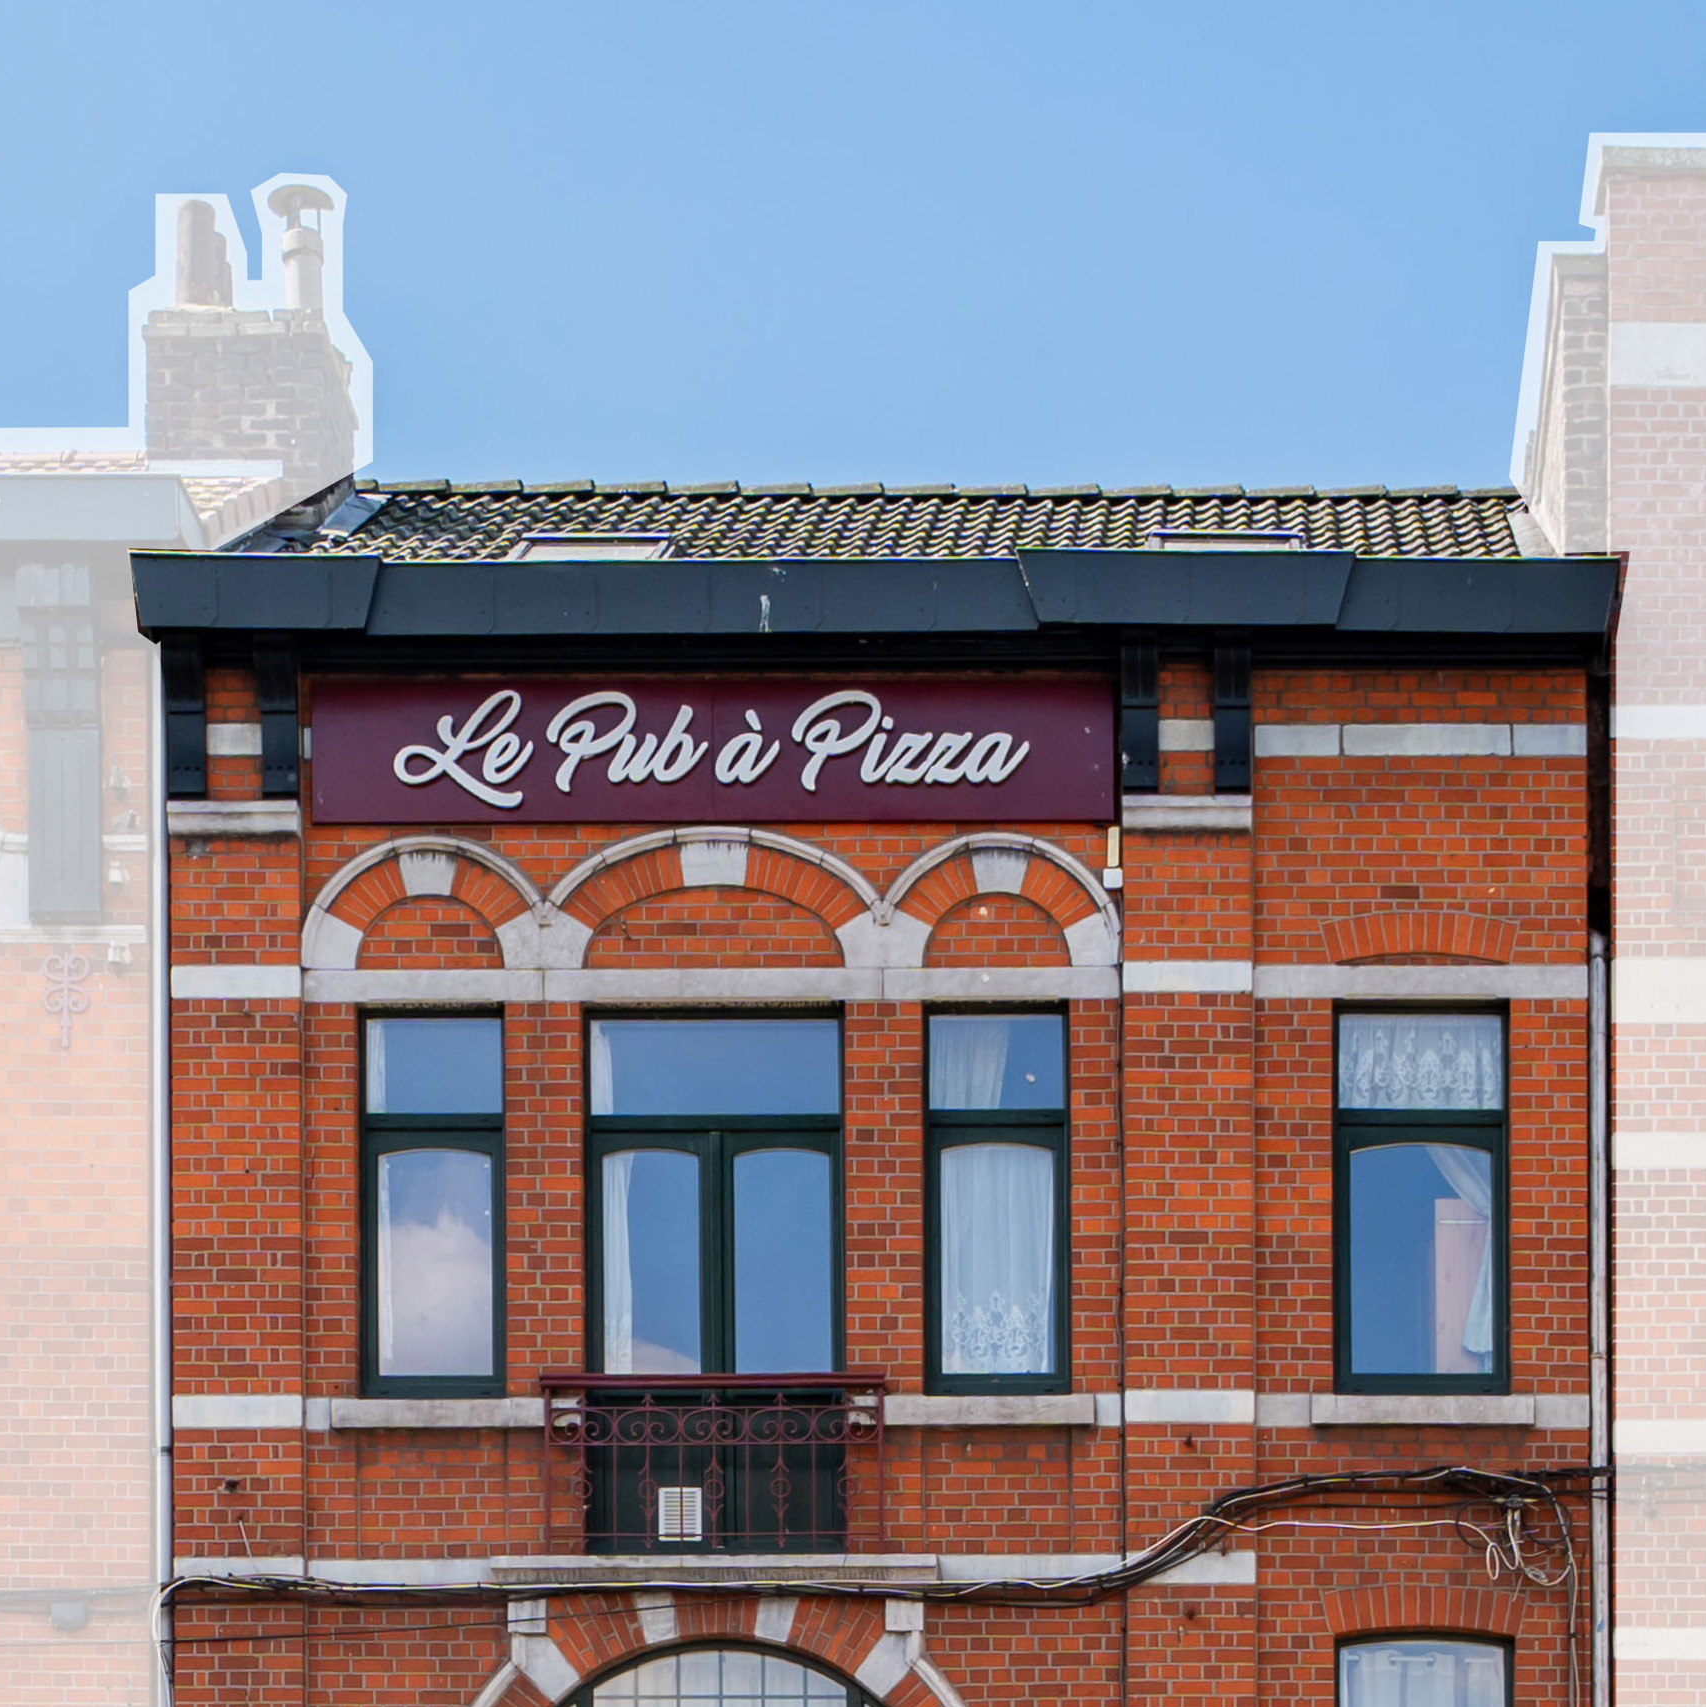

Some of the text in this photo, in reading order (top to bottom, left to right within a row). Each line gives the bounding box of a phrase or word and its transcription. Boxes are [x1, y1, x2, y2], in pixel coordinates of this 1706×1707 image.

[393, 689, 1031, 808] Le Pub à Pizza
